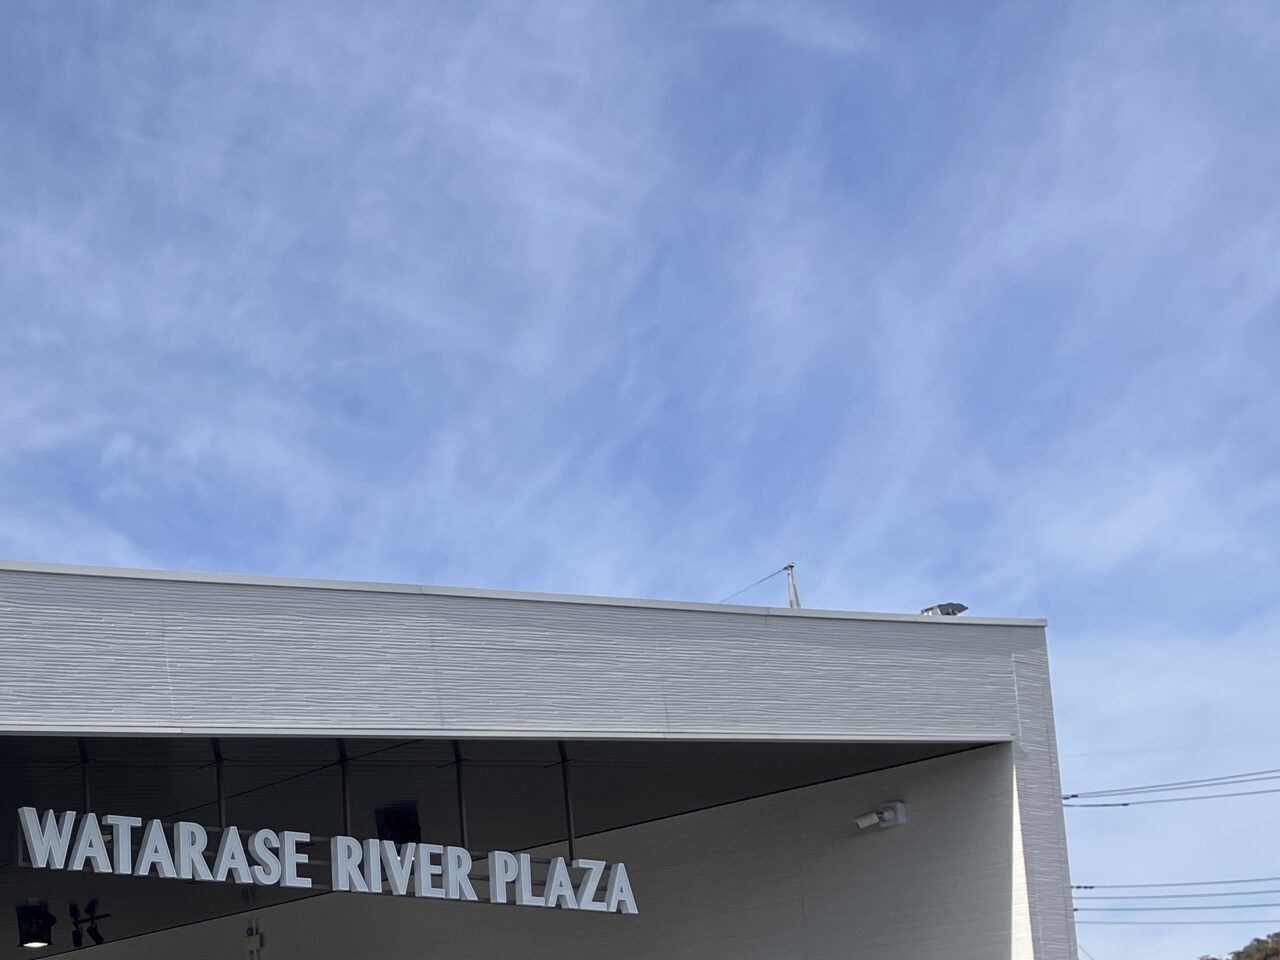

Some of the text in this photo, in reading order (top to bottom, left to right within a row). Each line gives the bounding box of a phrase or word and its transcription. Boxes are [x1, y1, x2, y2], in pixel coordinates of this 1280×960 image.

[18, 806, 639, 914] WATARASE RIVER PLAZA
